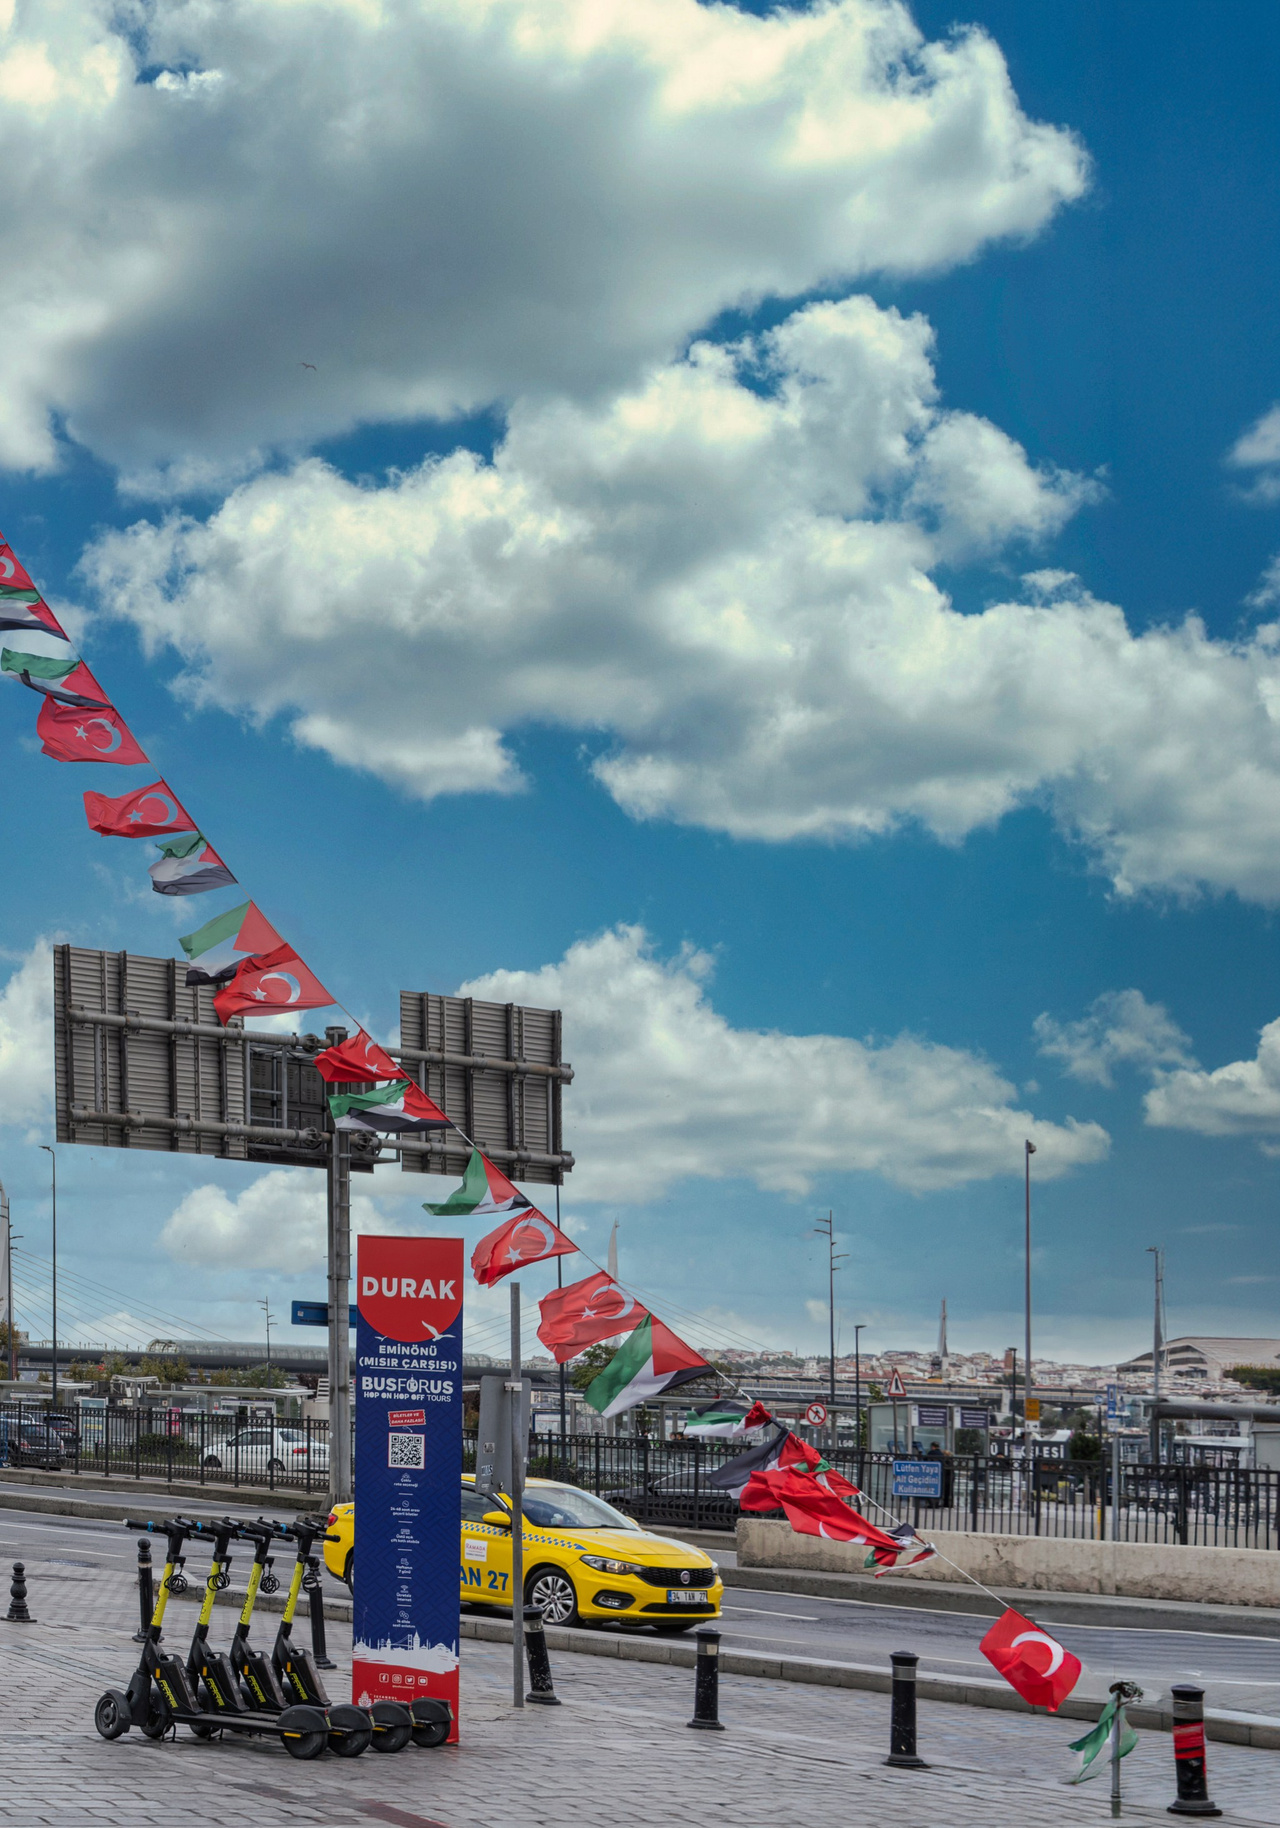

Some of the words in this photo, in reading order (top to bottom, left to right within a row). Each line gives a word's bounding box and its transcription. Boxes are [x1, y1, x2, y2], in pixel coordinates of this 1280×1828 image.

[362, 1276, 456, 1300] DURAK
[379, 1343, 437, 1356] EMİNÖNÜ
[359, 1357, 398, 1367] (MISIR
[402, 1359, 457, 1371] ÇARŞISI)
[362, 1376, 453, 1394] BUSFORUS
[426, 1394, 451, 1402] TOURS
[896, 1464, 920, 1472] Lütfen
[921, 1465, 939, 1474] Yaya
[896, 1475, 906, 1483] Alt
[907, 1475, 938, 1485] Geçidini
[466, 1543, 486, 1551] RAMADA
[460, 1565, 481, 1587] AN
[487, 1570, 509, 1591] 27
[672, 1592, 680, 1600] 34
[684, 1592, 695, 1602] TAN
[699, 1593, 705, 1603] 27
